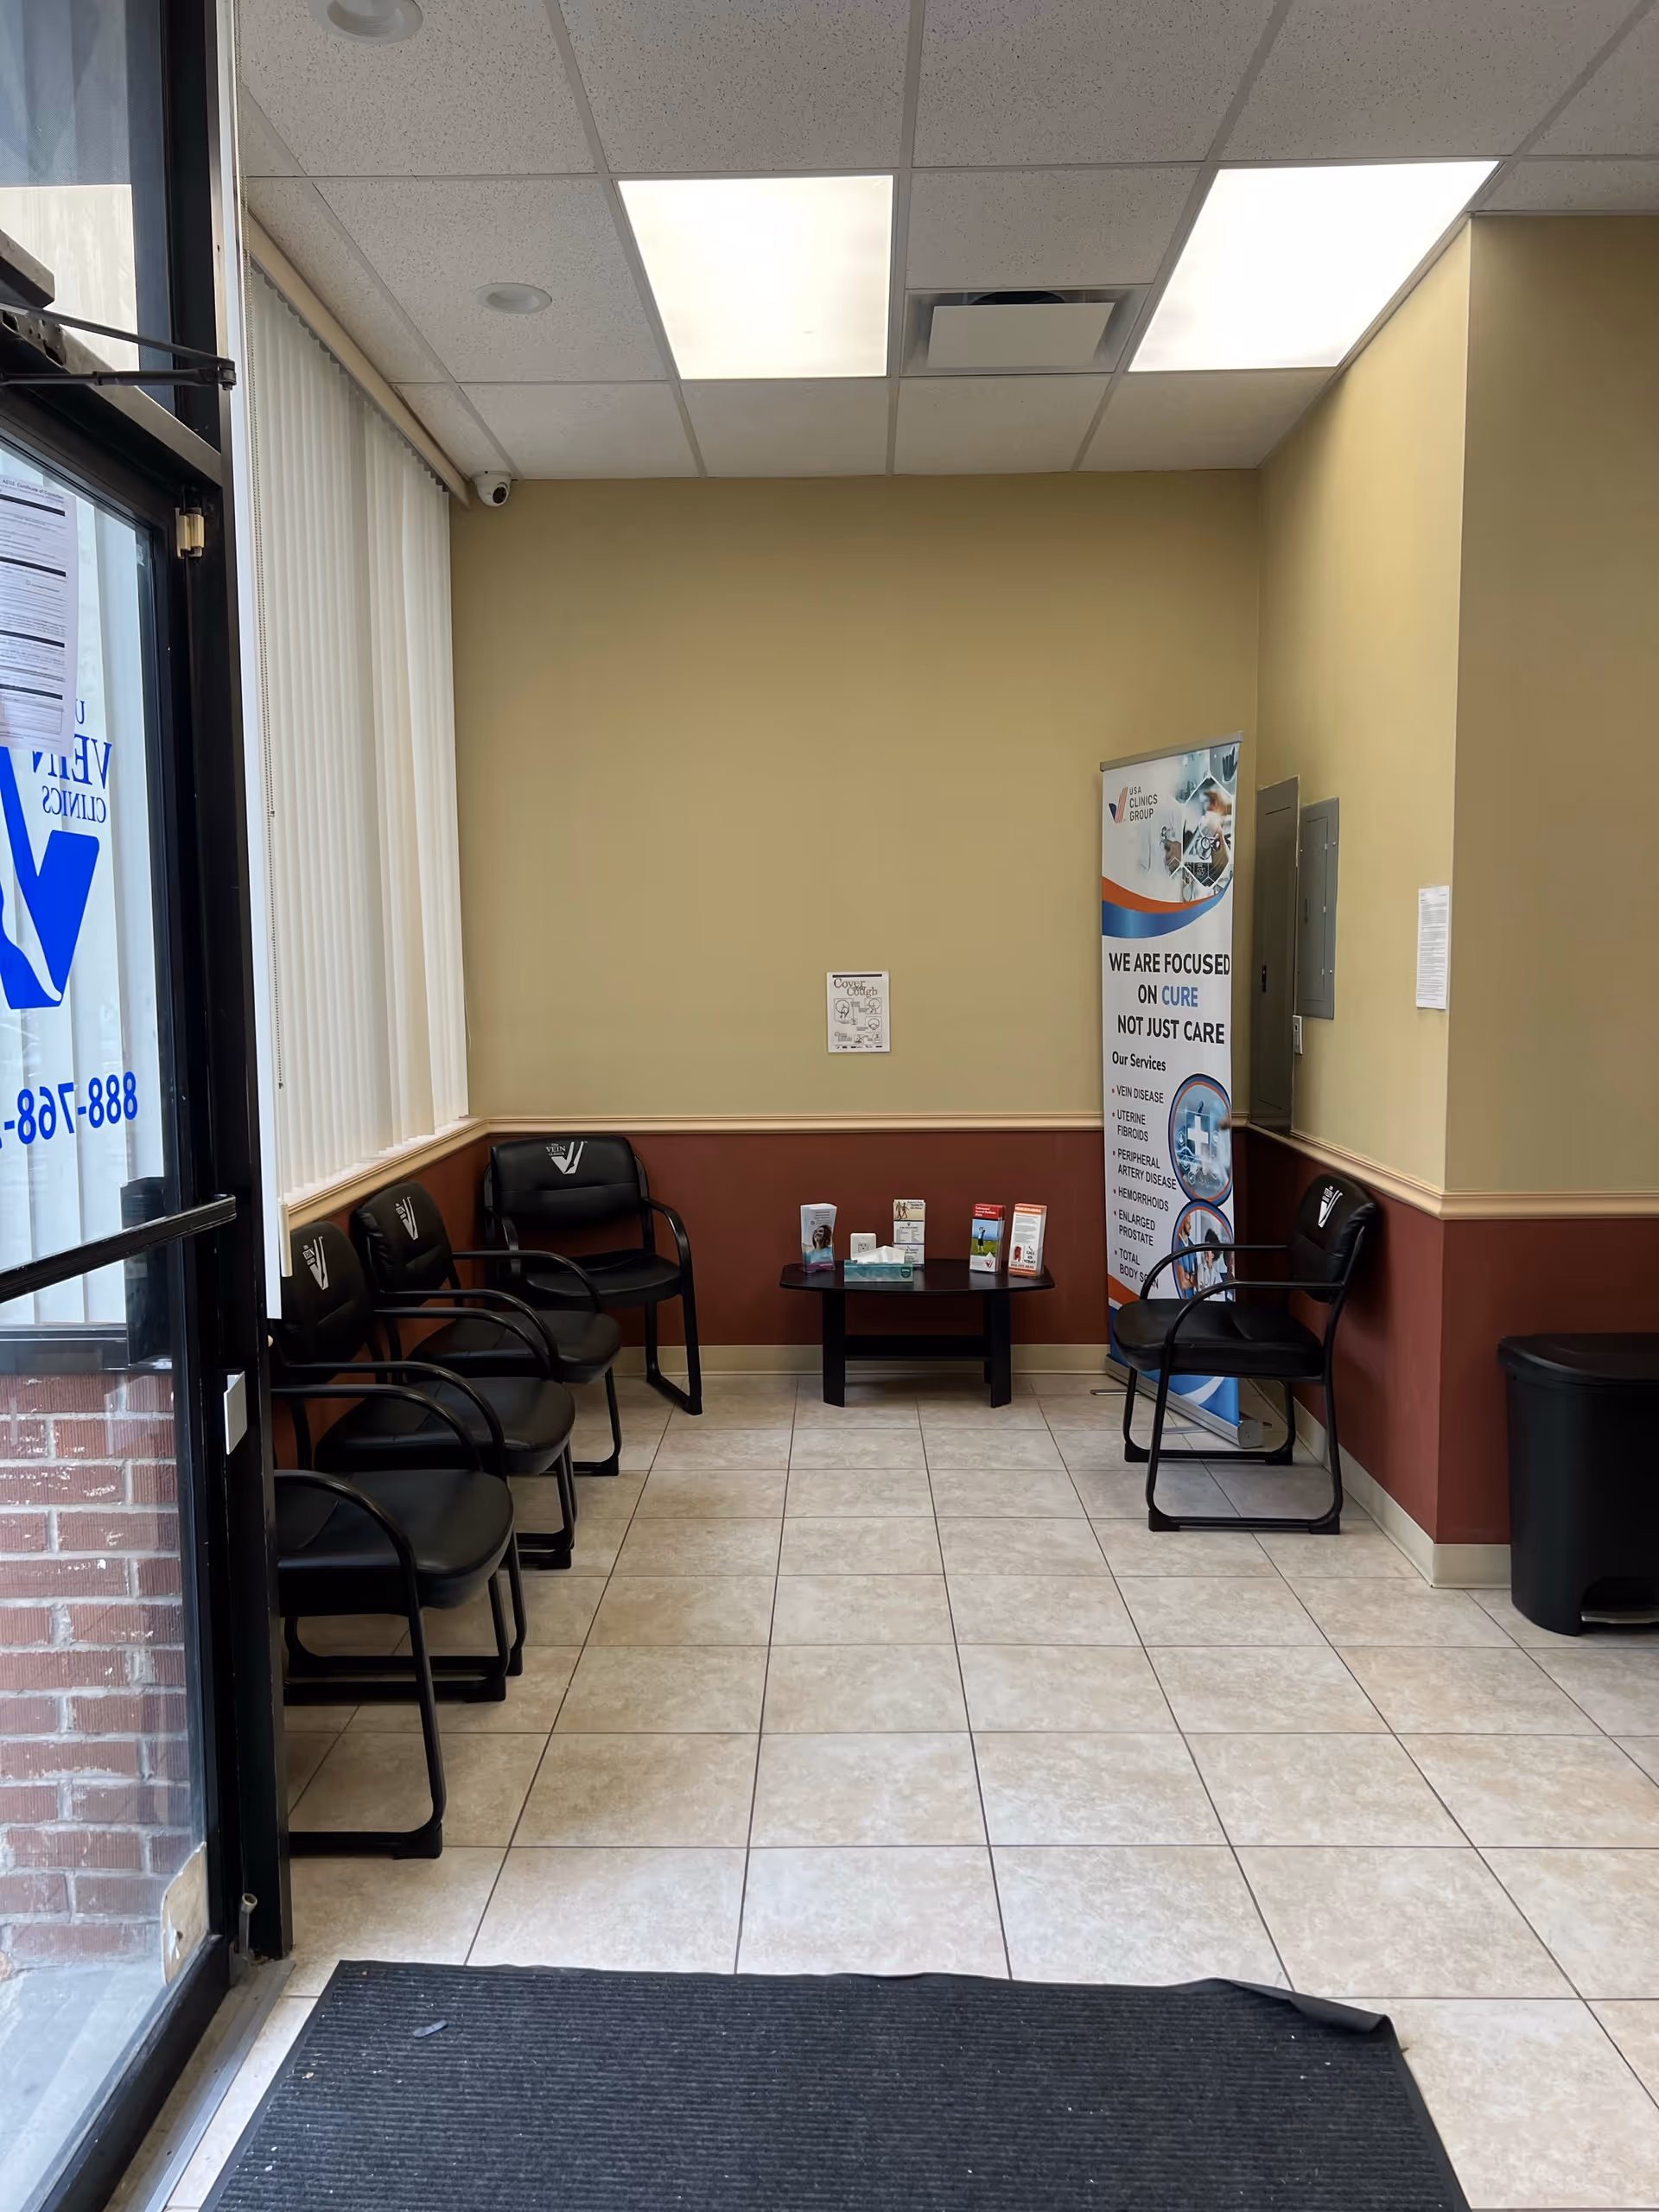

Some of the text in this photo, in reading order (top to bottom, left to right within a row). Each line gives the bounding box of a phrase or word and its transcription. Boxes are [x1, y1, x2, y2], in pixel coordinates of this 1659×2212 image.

[1128, 785, 1141, 796] USA
[1128, 793, 1158, 809] CLINICS
[1129, 808, 1154, 822] GROUP
[1109, 952, 1230, 976] WE ARE FOCUSED
[833, 978, 866, 988] Cover
[1137, 984, 1198, 1007] ON CURE
[1117, 1014, 1225, 1045] NOT JUST CARE
[1112, 1051, 1166, 1071] Our Services
[1116, 1084, 1165, 1104] VEIN DISEASE
[1116, 1109, 1146, 1126] UTERINE
[1117, 1125, 1149, 1142] FIBROIDS
[1117, 1147, 1160, 1170] PERIPHERAL
[1117, 1164, 1178, 1191] ARTERY DISEASE
[1118, 1186, 1170, 1212] HEMORRHOIDS
[1118, 1209, 1156, 1231] ENLARGED
[1118, 1224, 1154, 1247] PROSTATE
[1119, 1248, 1141, 1266] TOTAL
[1119, 1263, 1138, 1280] BODY
